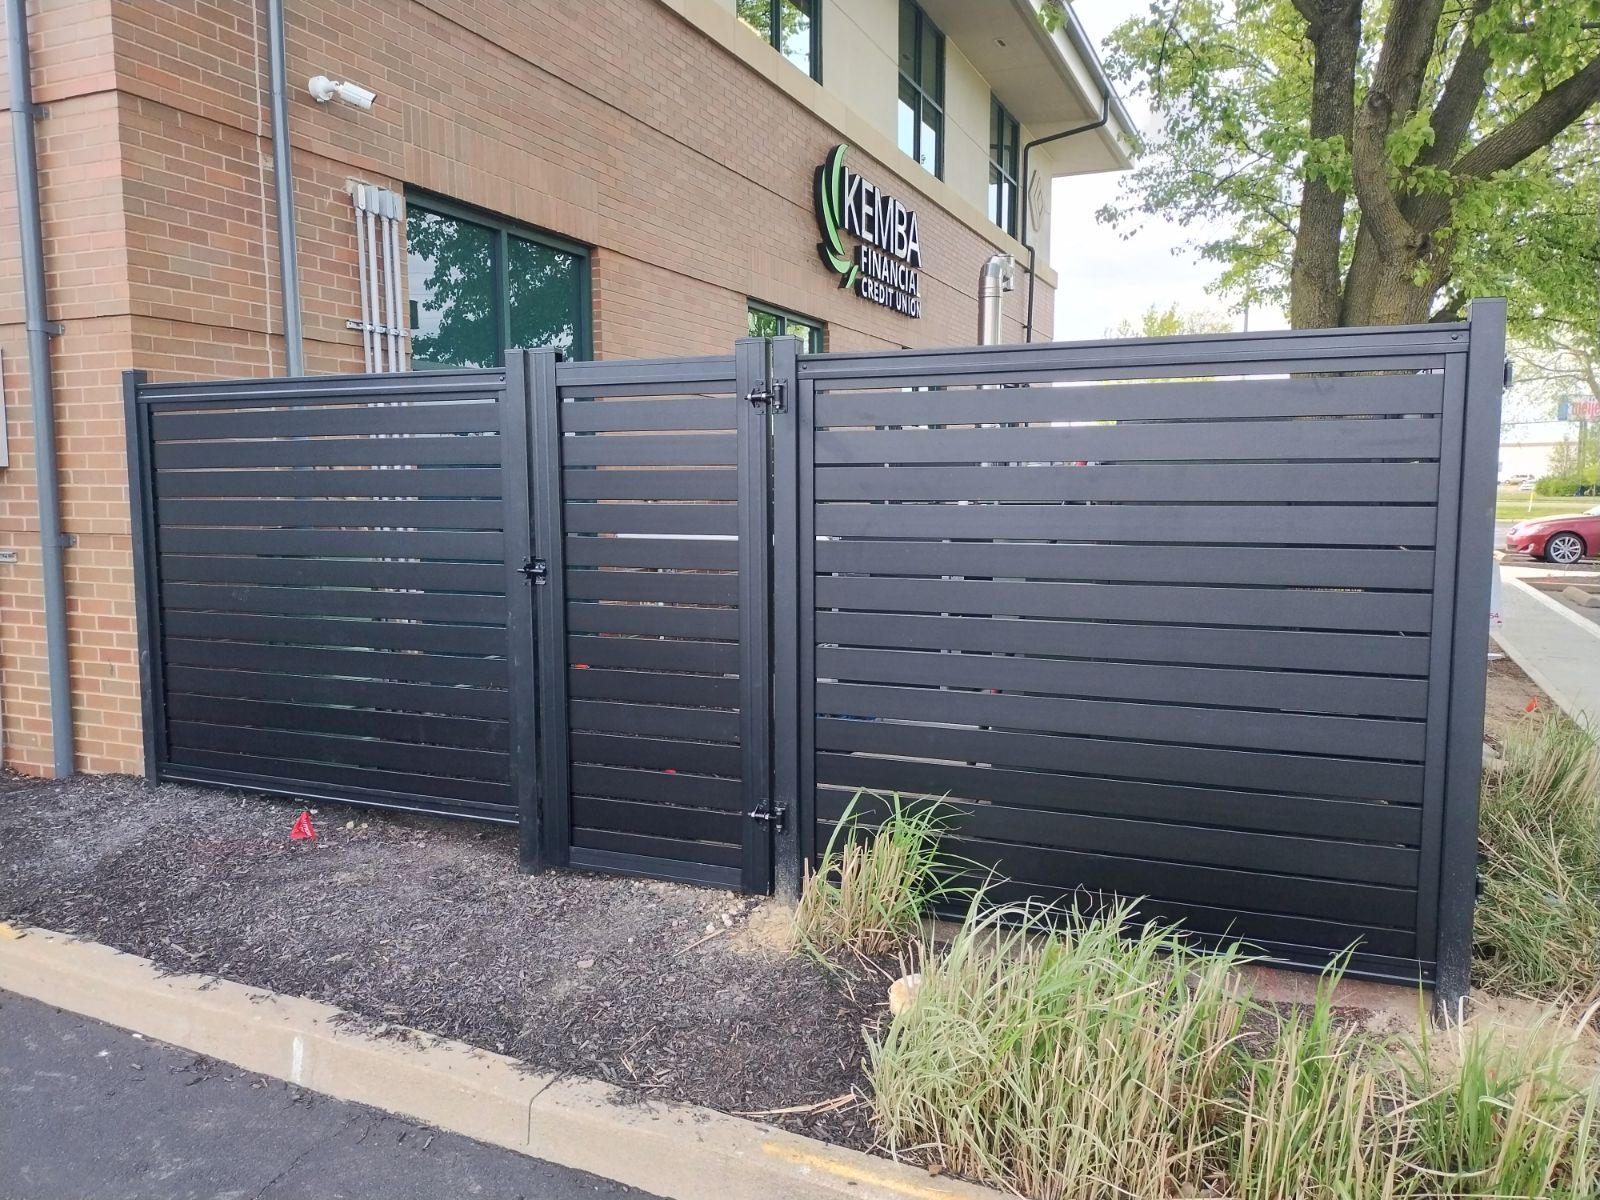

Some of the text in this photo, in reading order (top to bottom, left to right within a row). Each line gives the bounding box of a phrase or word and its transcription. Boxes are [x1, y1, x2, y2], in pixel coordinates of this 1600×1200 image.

[844, 166, 922, 268] KEMBA
[861, 244, 921, 298] FINANCIAL
[861, 276, 922, 319] CREDIT UNION
